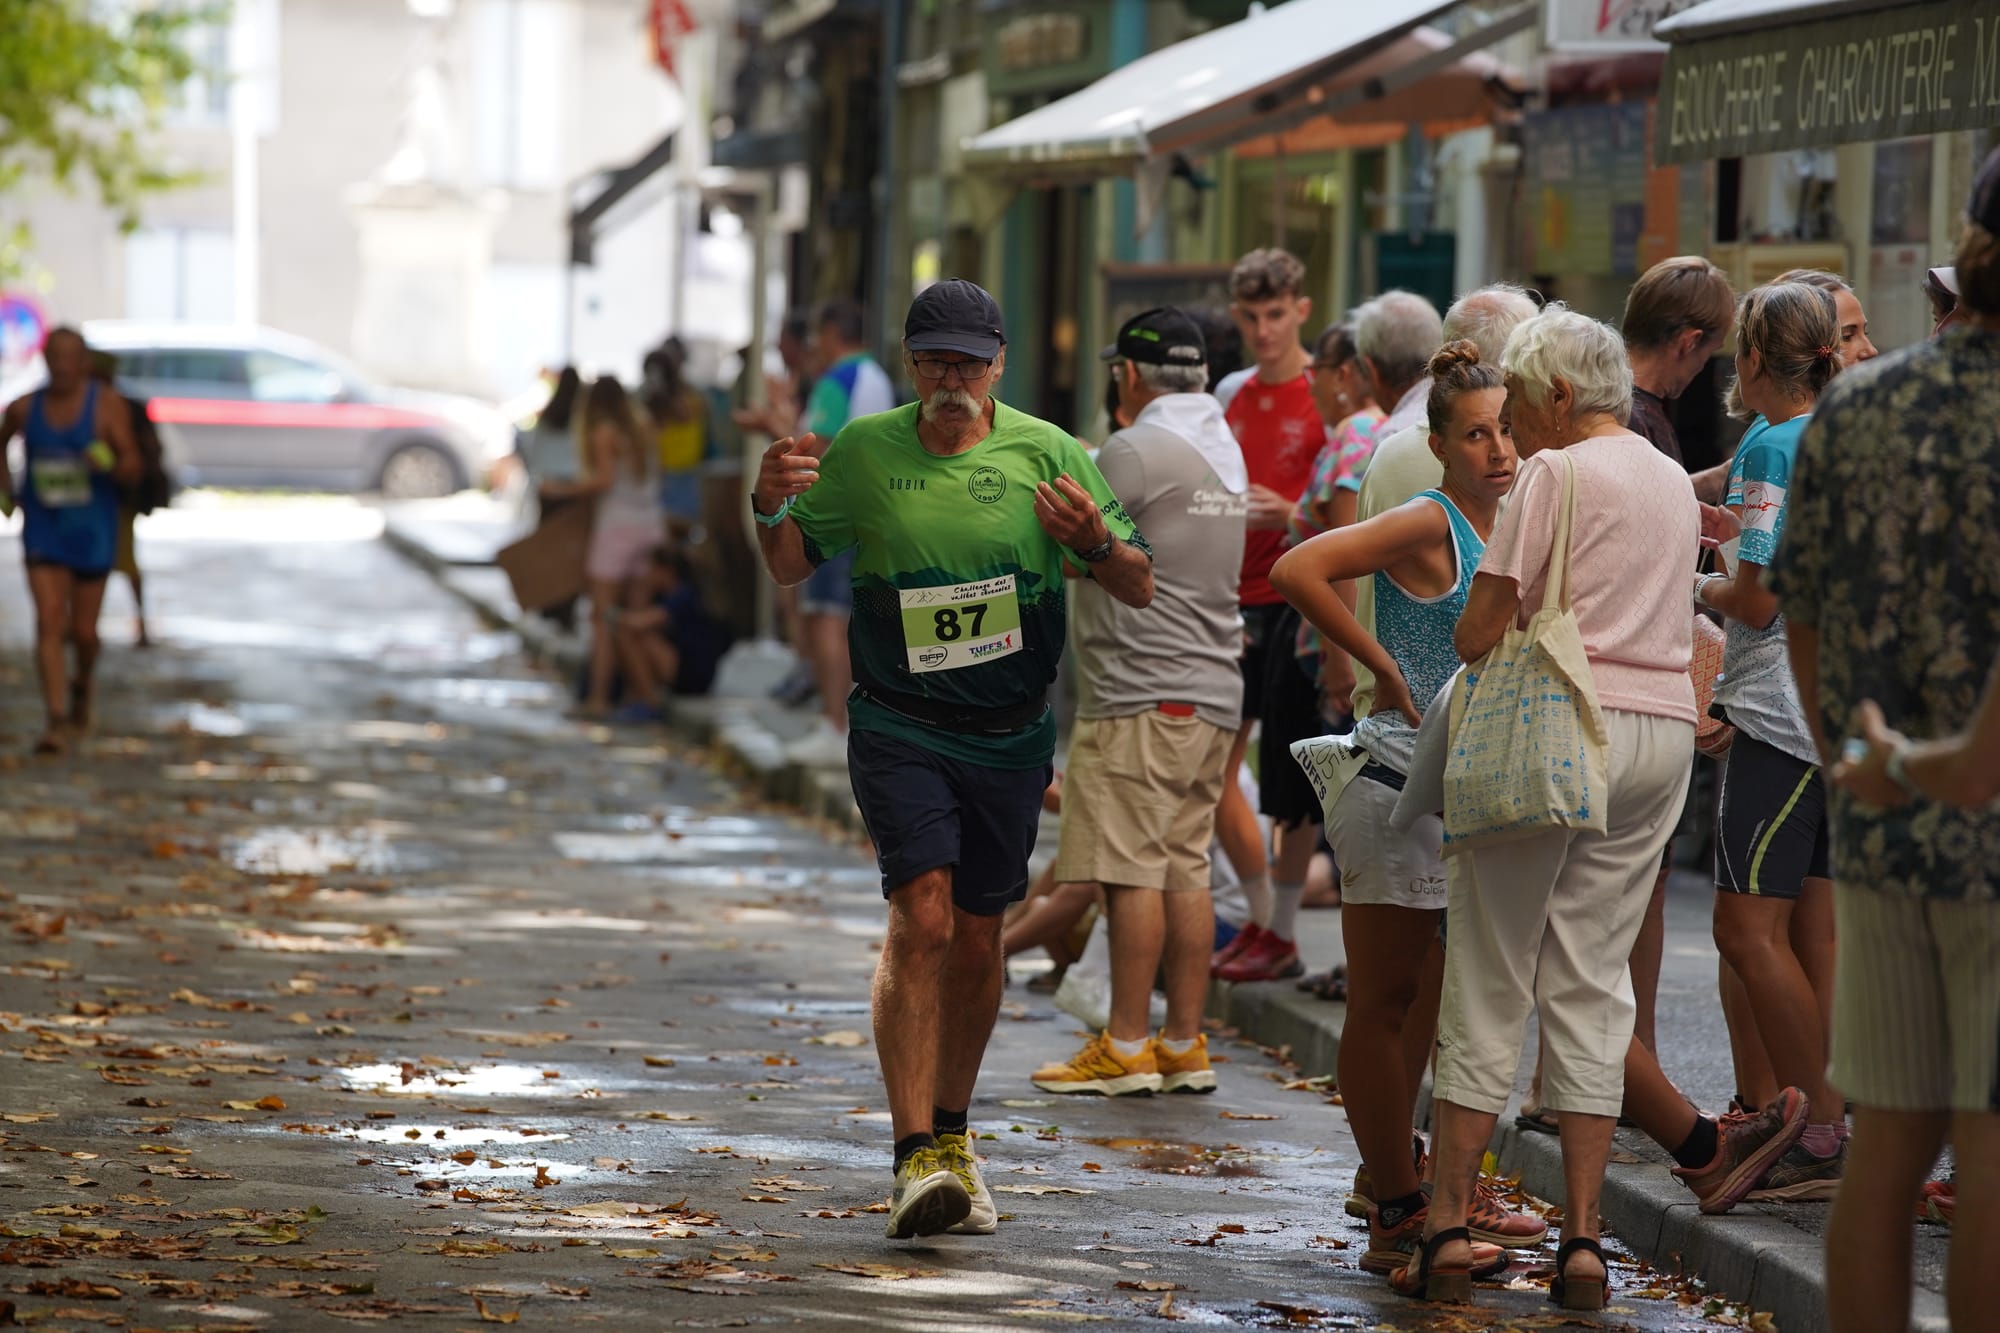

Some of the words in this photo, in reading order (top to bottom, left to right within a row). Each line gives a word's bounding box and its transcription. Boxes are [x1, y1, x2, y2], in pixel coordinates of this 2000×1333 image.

[1670, 52, 1787, 146] BOUCHERIE
[1796, 25, 1957, 130] CHARCUTERIE
[954, 584, 990, 593] Challenge
[994, 578, 1006, 586] des
[933, 603, 988, 641] 87
[920, 653, 943, 661] BFP
[969, 641, 1002, 654] TUFF'S
[1297, 746, 1326, 800] TUFF'S
